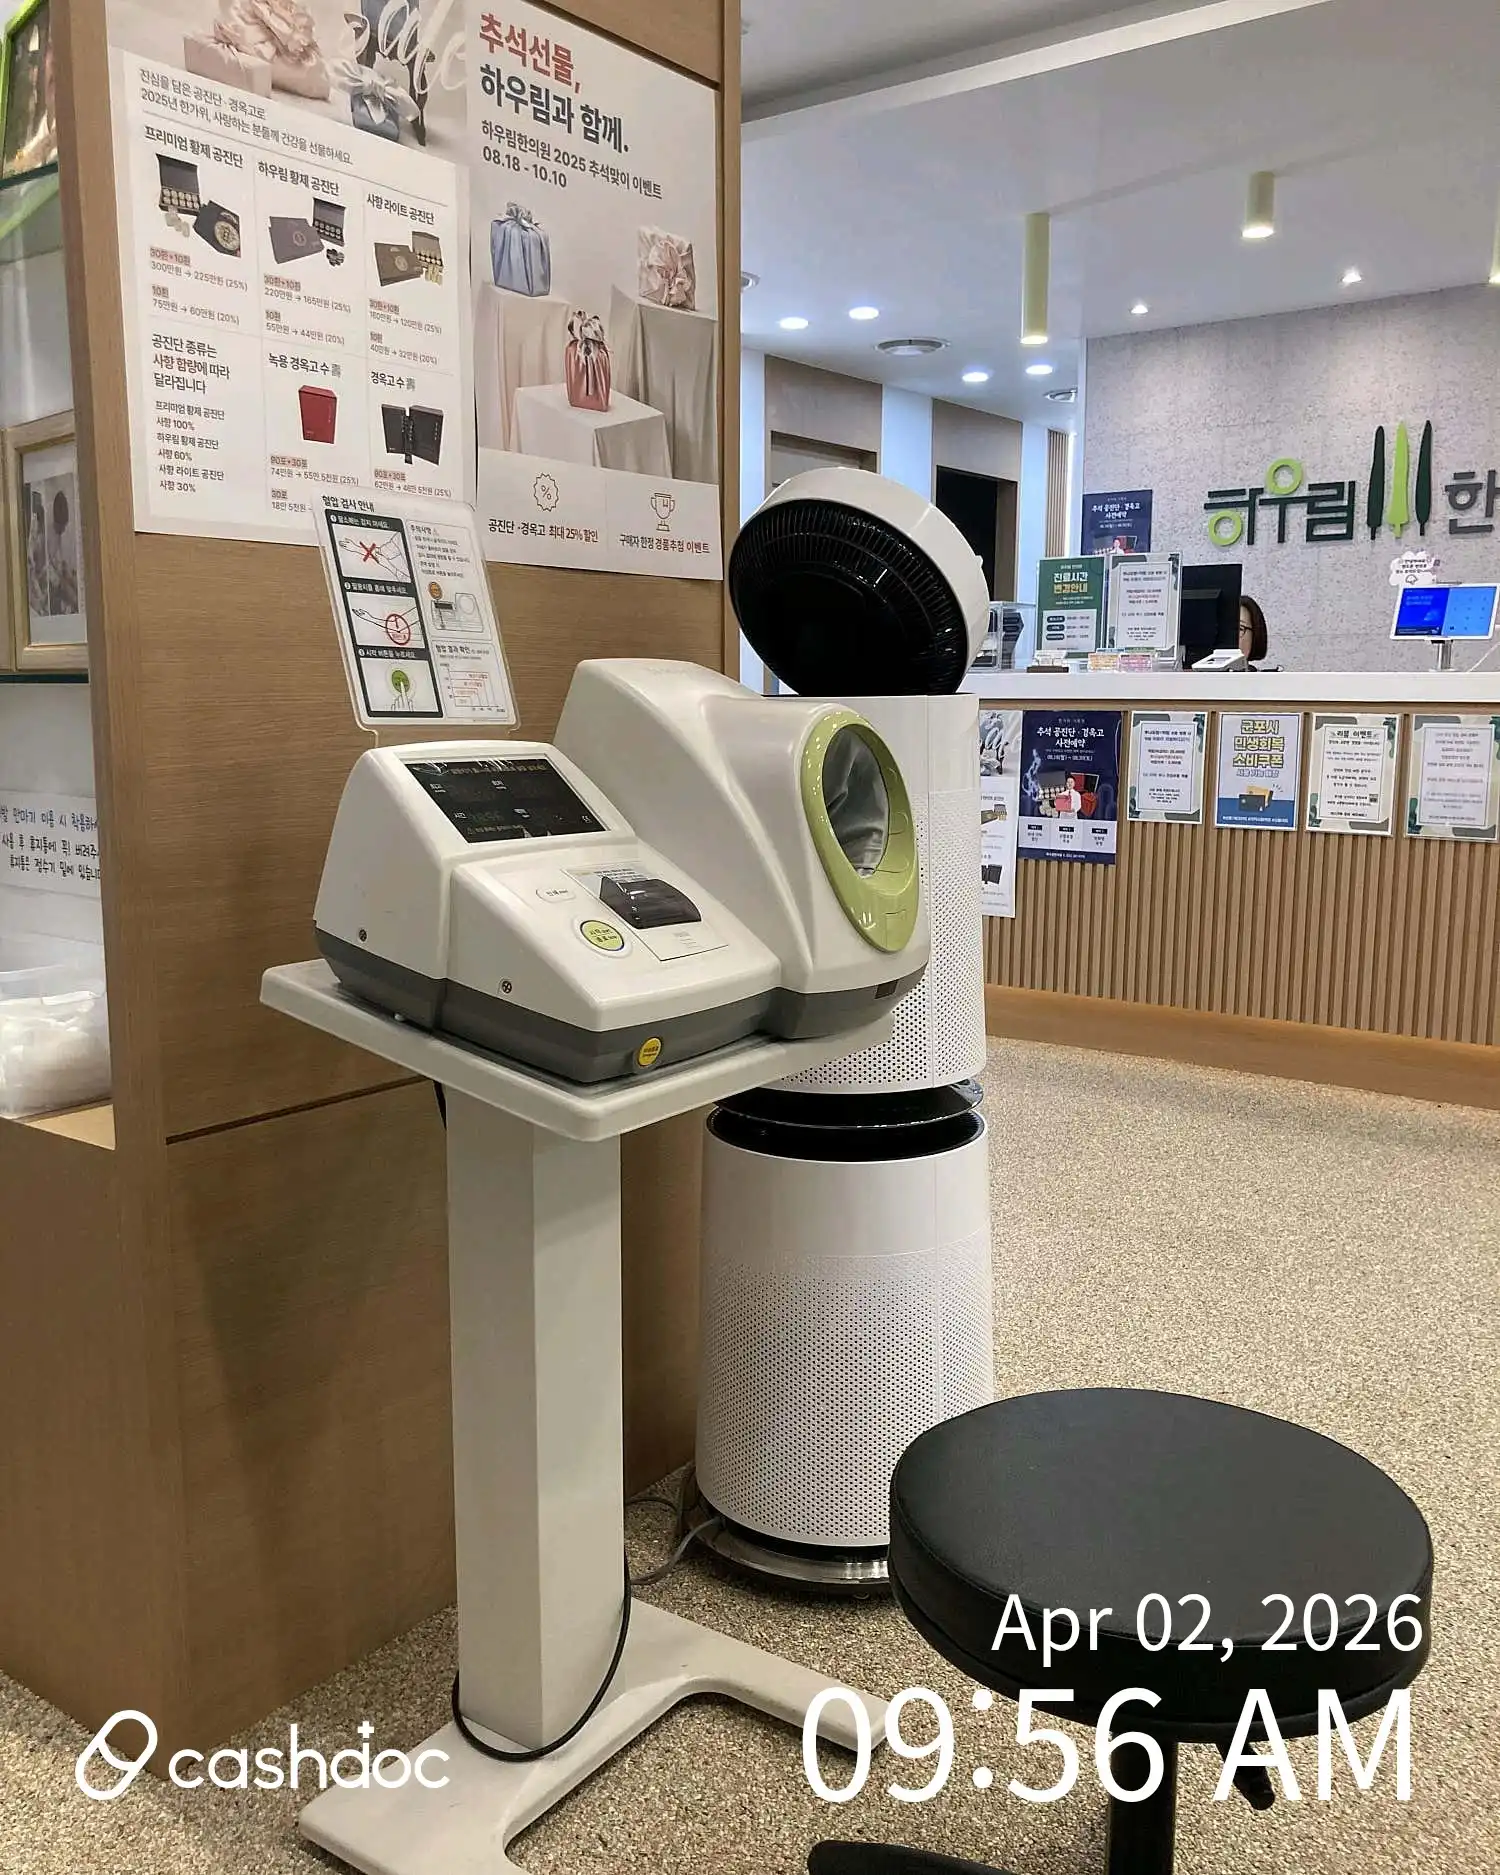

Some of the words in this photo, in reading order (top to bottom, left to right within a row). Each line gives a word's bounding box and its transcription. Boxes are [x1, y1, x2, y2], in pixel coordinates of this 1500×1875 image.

[479, 12, 581, 94] 추석선물,
[139, 68, 169, 89] 진심을
[172, 80, 192, 97] 담은
[193, 85, 222, 107] 공진단
[228, 97, 266, 120] 경옥고로
[480, 63, 575, 134] 하우림과
[579, 103, 629, 154] 함께.
[141, 87, 177, 111] 2025년
[181, 101, 211, 123] 한가위,
[213, 111, 250, 134] 사랑하는
[252, 123, 280, 144] 분들께
[281, 133, 307, 150] 건강을
[144, 125, 188, 151] 프리미엄
[189, 138, 211, 159] 황제
[212, 146, 244, 169] 공진단
[481, 119, 551, 162] 하우림한의원
[554, 148, 586, 172] 2025
[588, 159, 630, 189] 추석맞이
[632, 176, 663, 200] 이벤트
[482, 145, 521, 172] 08.18
[532, 163, 567, 188] 10.10
[258, 161, 288, 183] 하우림
[290, 170, 310, 189] 황제
[310, 176, 340, 197] 공진단
[367, 193, 383, 211] 사향
[384, 199, 408, 217] 라이트
[409, 207, 435, 226] 공진단
[226, 279, 248, 292] (25%)
[152, 334, 183, 351] 공진단
[185, 340, 217, 358] 종류는
[153, 353, 174, 369] 사향
[177, 357, 208, 376] 함량에
[210, 364, 230, 380] 따라
[268, 352, 288, 369] 녹용
[290, 356, 319, 373] 경옥고
[320, 362, 330, 375] 수
[154, 373, 206, 394] 달라집니다
[371, 371, 395, 387] 경옥고
[397, 377, 405, 388] 수
[156, 401, 185, 415] 프리미엄
[186, 405, 202, 417] 황제
[203, 407, 225, 420] 공진단
[156, 417, 171, 428] 사향
[173, 419, 195, 430] 100%
[157, 433, 179, 445] 하우림
[181, 436, 196, 447] 황제
[197, 438, 218, 449] 공진단
[158, 449, 173, 460] 사향
[174, 451, 192, 461] 60%
[159, 465, 174, 476] 사향
[176, 467, 200, 478] 라이트
[201, 469, 224, 481] 공진단
[160, 480, 175, 491] 사향
[177, 483, 196, 492] 30%
[341, 499, 357, 511] 검사
[358, 501, 375, 512] 안내
[1204, 457, 1356, 546] 하우림
[1445, 469, 1500, 535] 한
[488, 518, 514, 535] 공진단
[548, 525, 565, 538] 최대
[566, 528, 583, 541] 25%
[584, 529, 599, 543] 할인
[619, 534, 640, 548] 구매자
[640, 535, 654, 550] 한정
[686, 541, 711, 554] 이벤트
[1054, 572, 1088, 583] 진료시간
[1037, 726, 1051, 737] 추석
[1053, 727, 1076, 737] 공진단
[1082, 728, 1104, 737] 경옥고
[1241, 719, 1279, 735] 군포시
[1353, 730, 1372, 739] 이벤트
[1056, 738, 1086, 748] 사전예약
[1234, 736, 1285, 752] 민생회복
[1233, 753, 1284, 768] 소비쿠폰
[41, 810, 54, 828] 이용
[60, 814, 67, 828] 시
[3, 832, 15, 849] 사용
[30, 835, 57, 854] 휴지통에
[34, 858, 56, 873] 정수기
